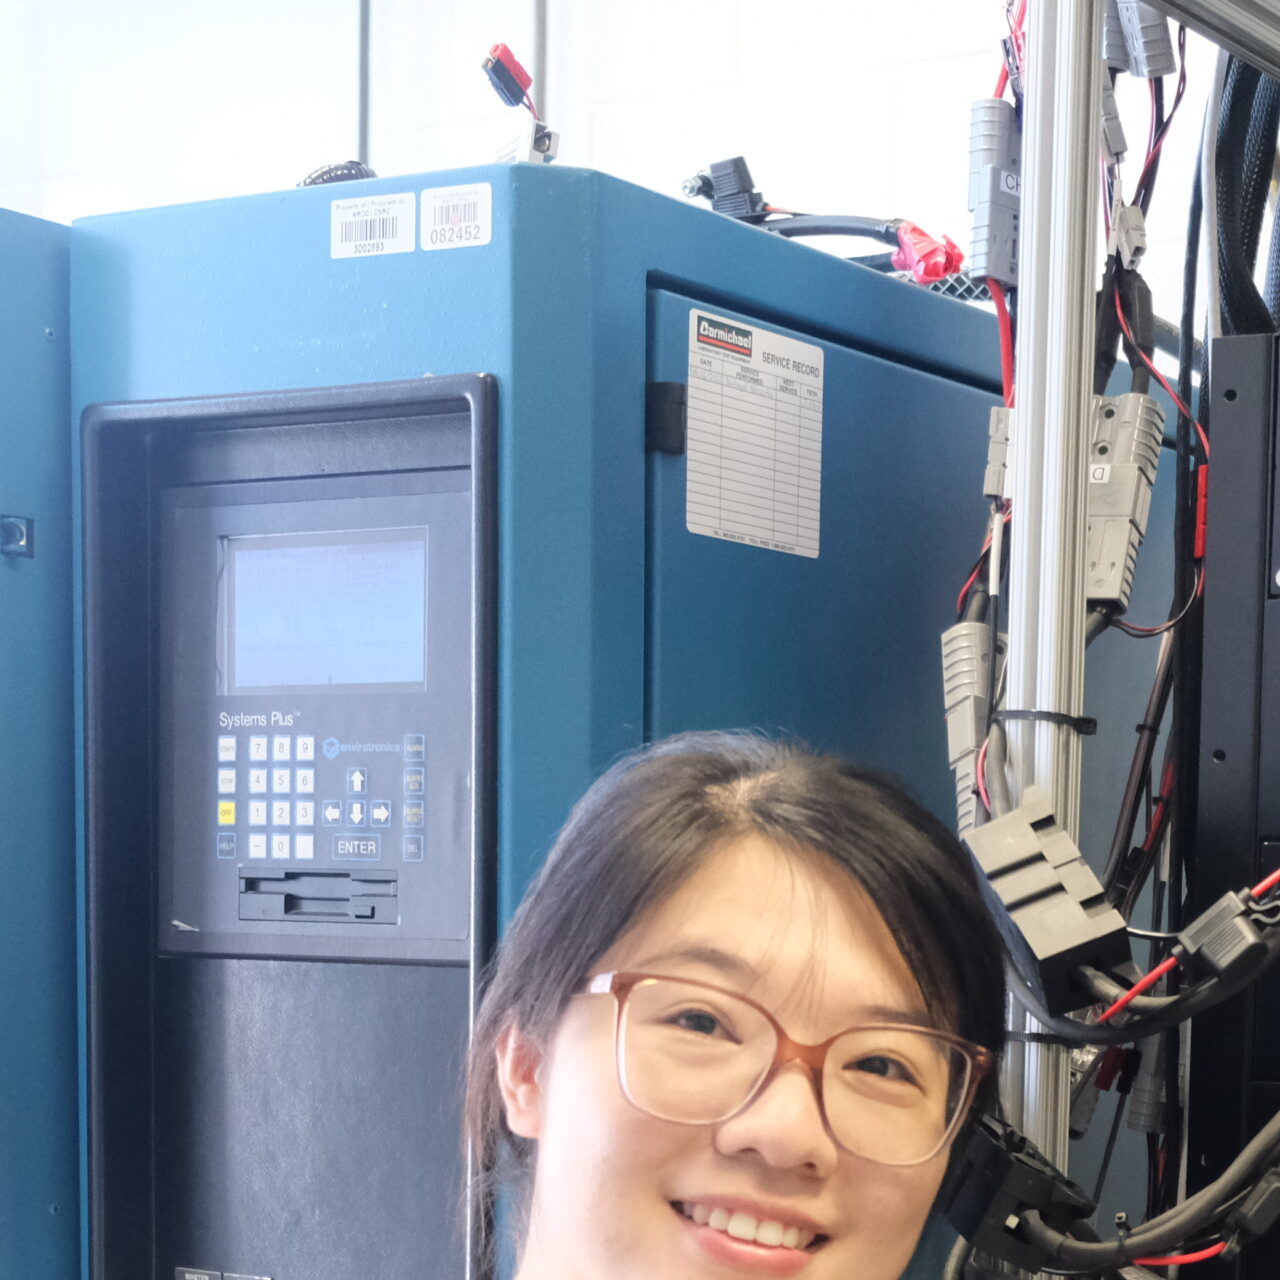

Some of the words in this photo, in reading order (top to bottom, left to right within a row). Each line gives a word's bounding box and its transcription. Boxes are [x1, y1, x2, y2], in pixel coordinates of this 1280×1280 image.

[430, 225, 480, 244] 082452
[354, 242, 384, 254] 3002893
[700, 321, 751, 349] Carmichael
[762, 352, 790, 370] SERVICE
[792, 360, 820, 378] RECORD
[219, 711, 267, 730] Systems
[256, 743, 261, 753] 7
[278, 742, 284, 754] 8
[302, 742, 308, 754] 9
[340, 742, 400, 752] envirotronics
[255, 775, 260, 785] 4
[278, 774, 284, 786] 5
[302, 776, 308, 786] 6
[278, 808, 284, 818] 2
[302, 808, 308, 818] 3
[278, 841, 284, 852] 0
[338, 841, 376, 854] ENTER
